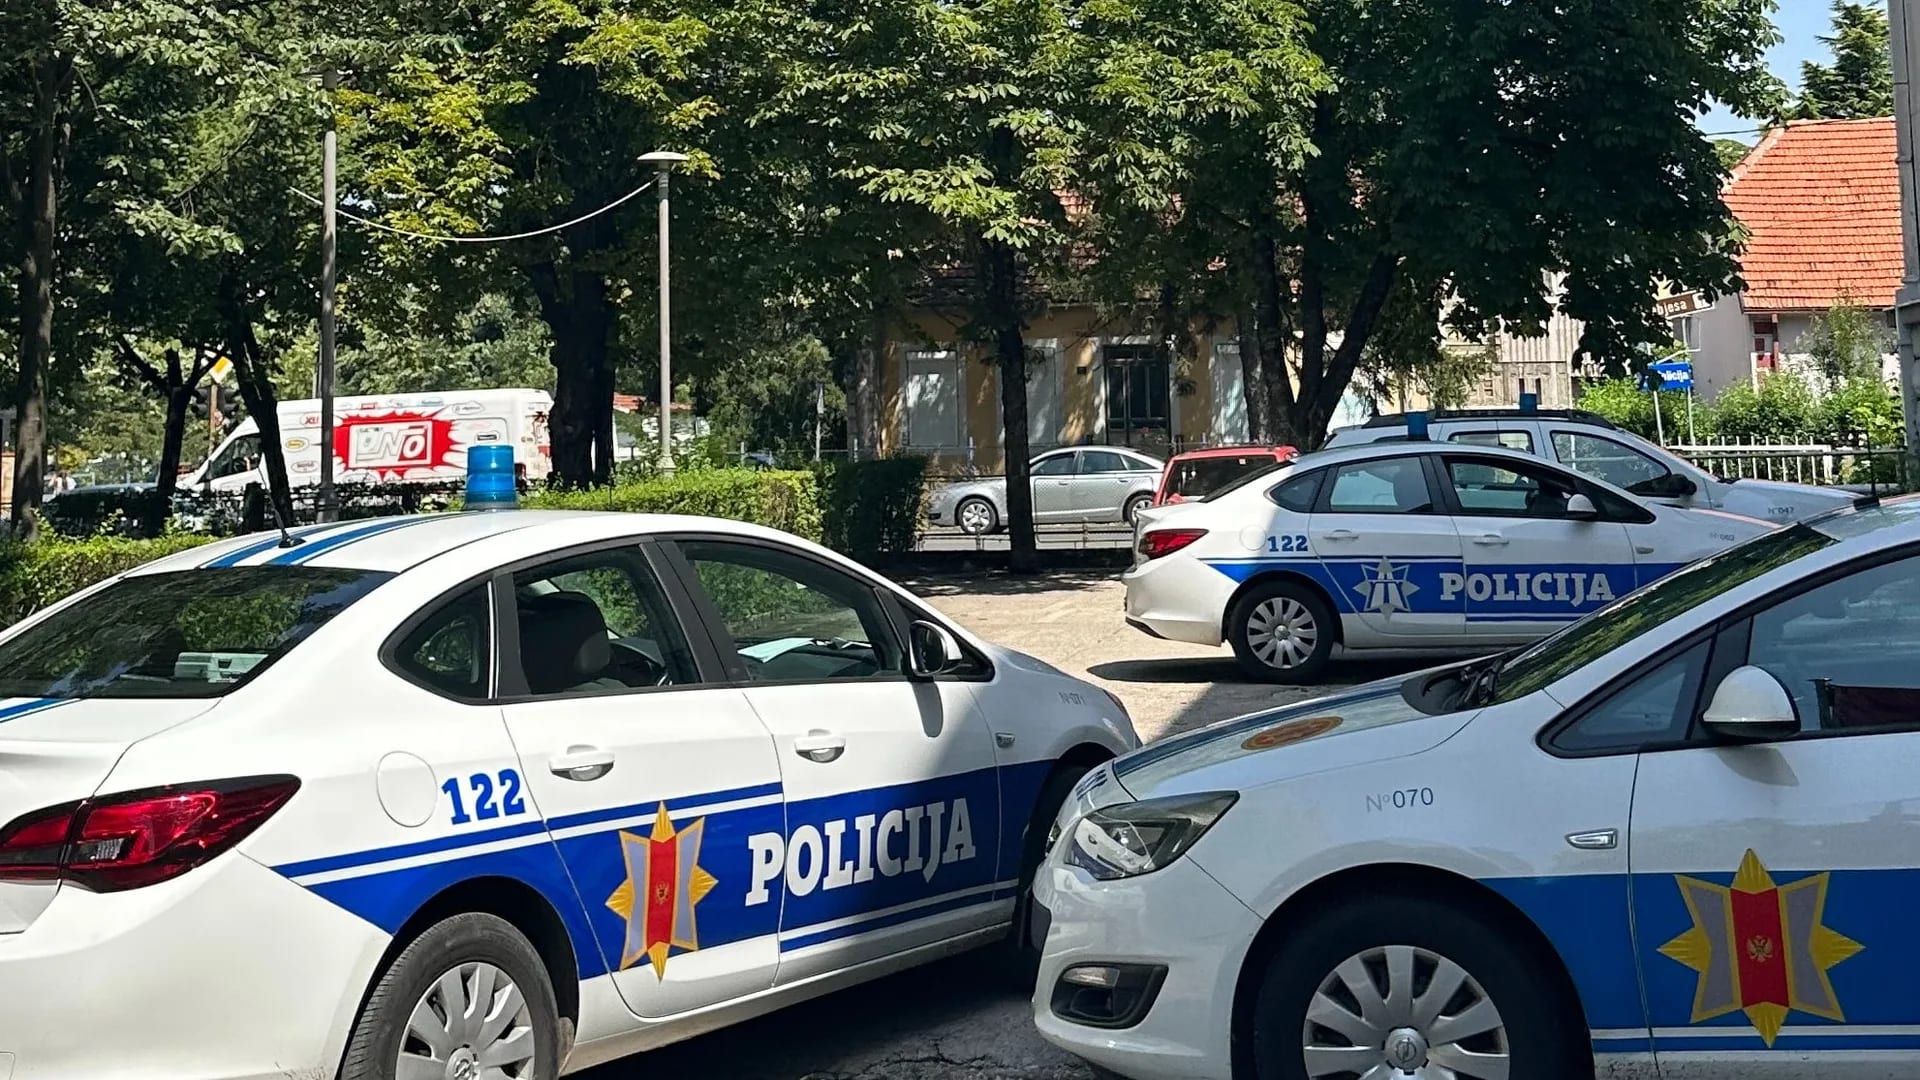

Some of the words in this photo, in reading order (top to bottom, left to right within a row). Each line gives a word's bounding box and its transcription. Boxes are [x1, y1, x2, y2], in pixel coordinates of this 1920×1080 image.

[1653, 299, 1688, 316] bjesa
[1660, 369, 1690, 382] licija
[1267, 534, 1309, 552] 122
[1438, 572, 1616, 608] POLICIJA
[441, 768, 526, 825] 122
[744, 797, 976, 907] POLICIJA
